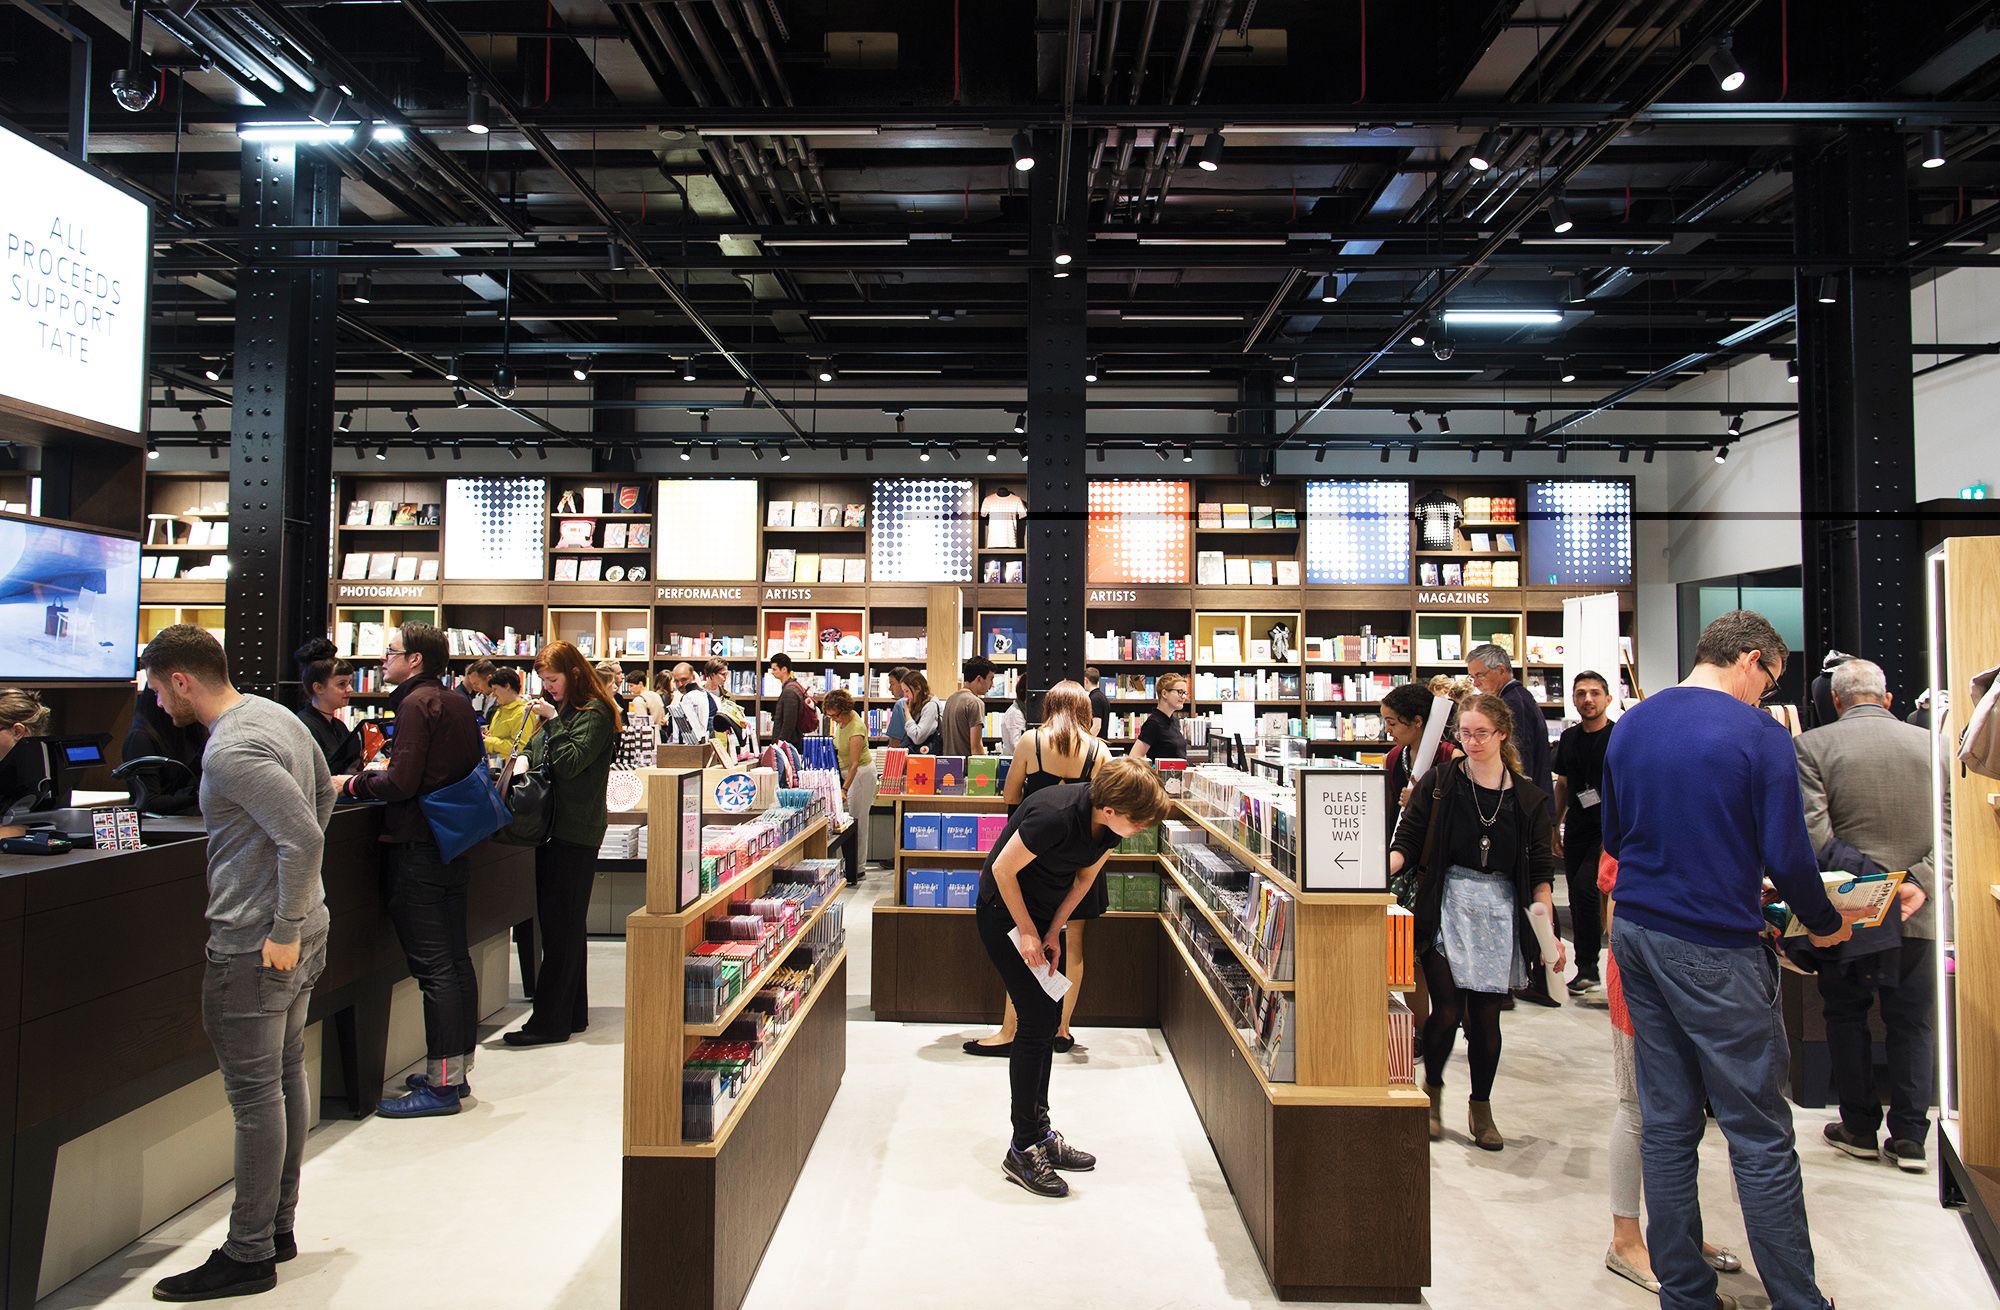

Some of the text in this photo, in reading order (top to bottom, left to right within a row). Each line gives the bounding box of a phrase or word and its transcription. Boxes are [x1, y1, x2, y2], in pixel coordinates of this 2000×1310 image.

[50, 217, 86, 256] ALL
[8, 232, 121, 305] PROCEEDS
[11, 273, 115, 337] SUPPORT
[38, 321, 88, 363] TATE
[419, 516, 437, 525] LIVE
[340, 586, 424, 597] PHOTOGRAPHY
[657, 588, 742, 599] PERFORMANCE
[765, 589, 812, 600] ARTISTS
[1090, 590, 1137, 602] ARTISTS
[1418, 592, 1489, 604] MAGAZINES
[1322, 791, 1367, 803] PLEASE
[1324, 804, 1366, 816] QUEUE
[1332, 818, 1360, 829] THIS
[1331, 831, 1360, 842] WAY
